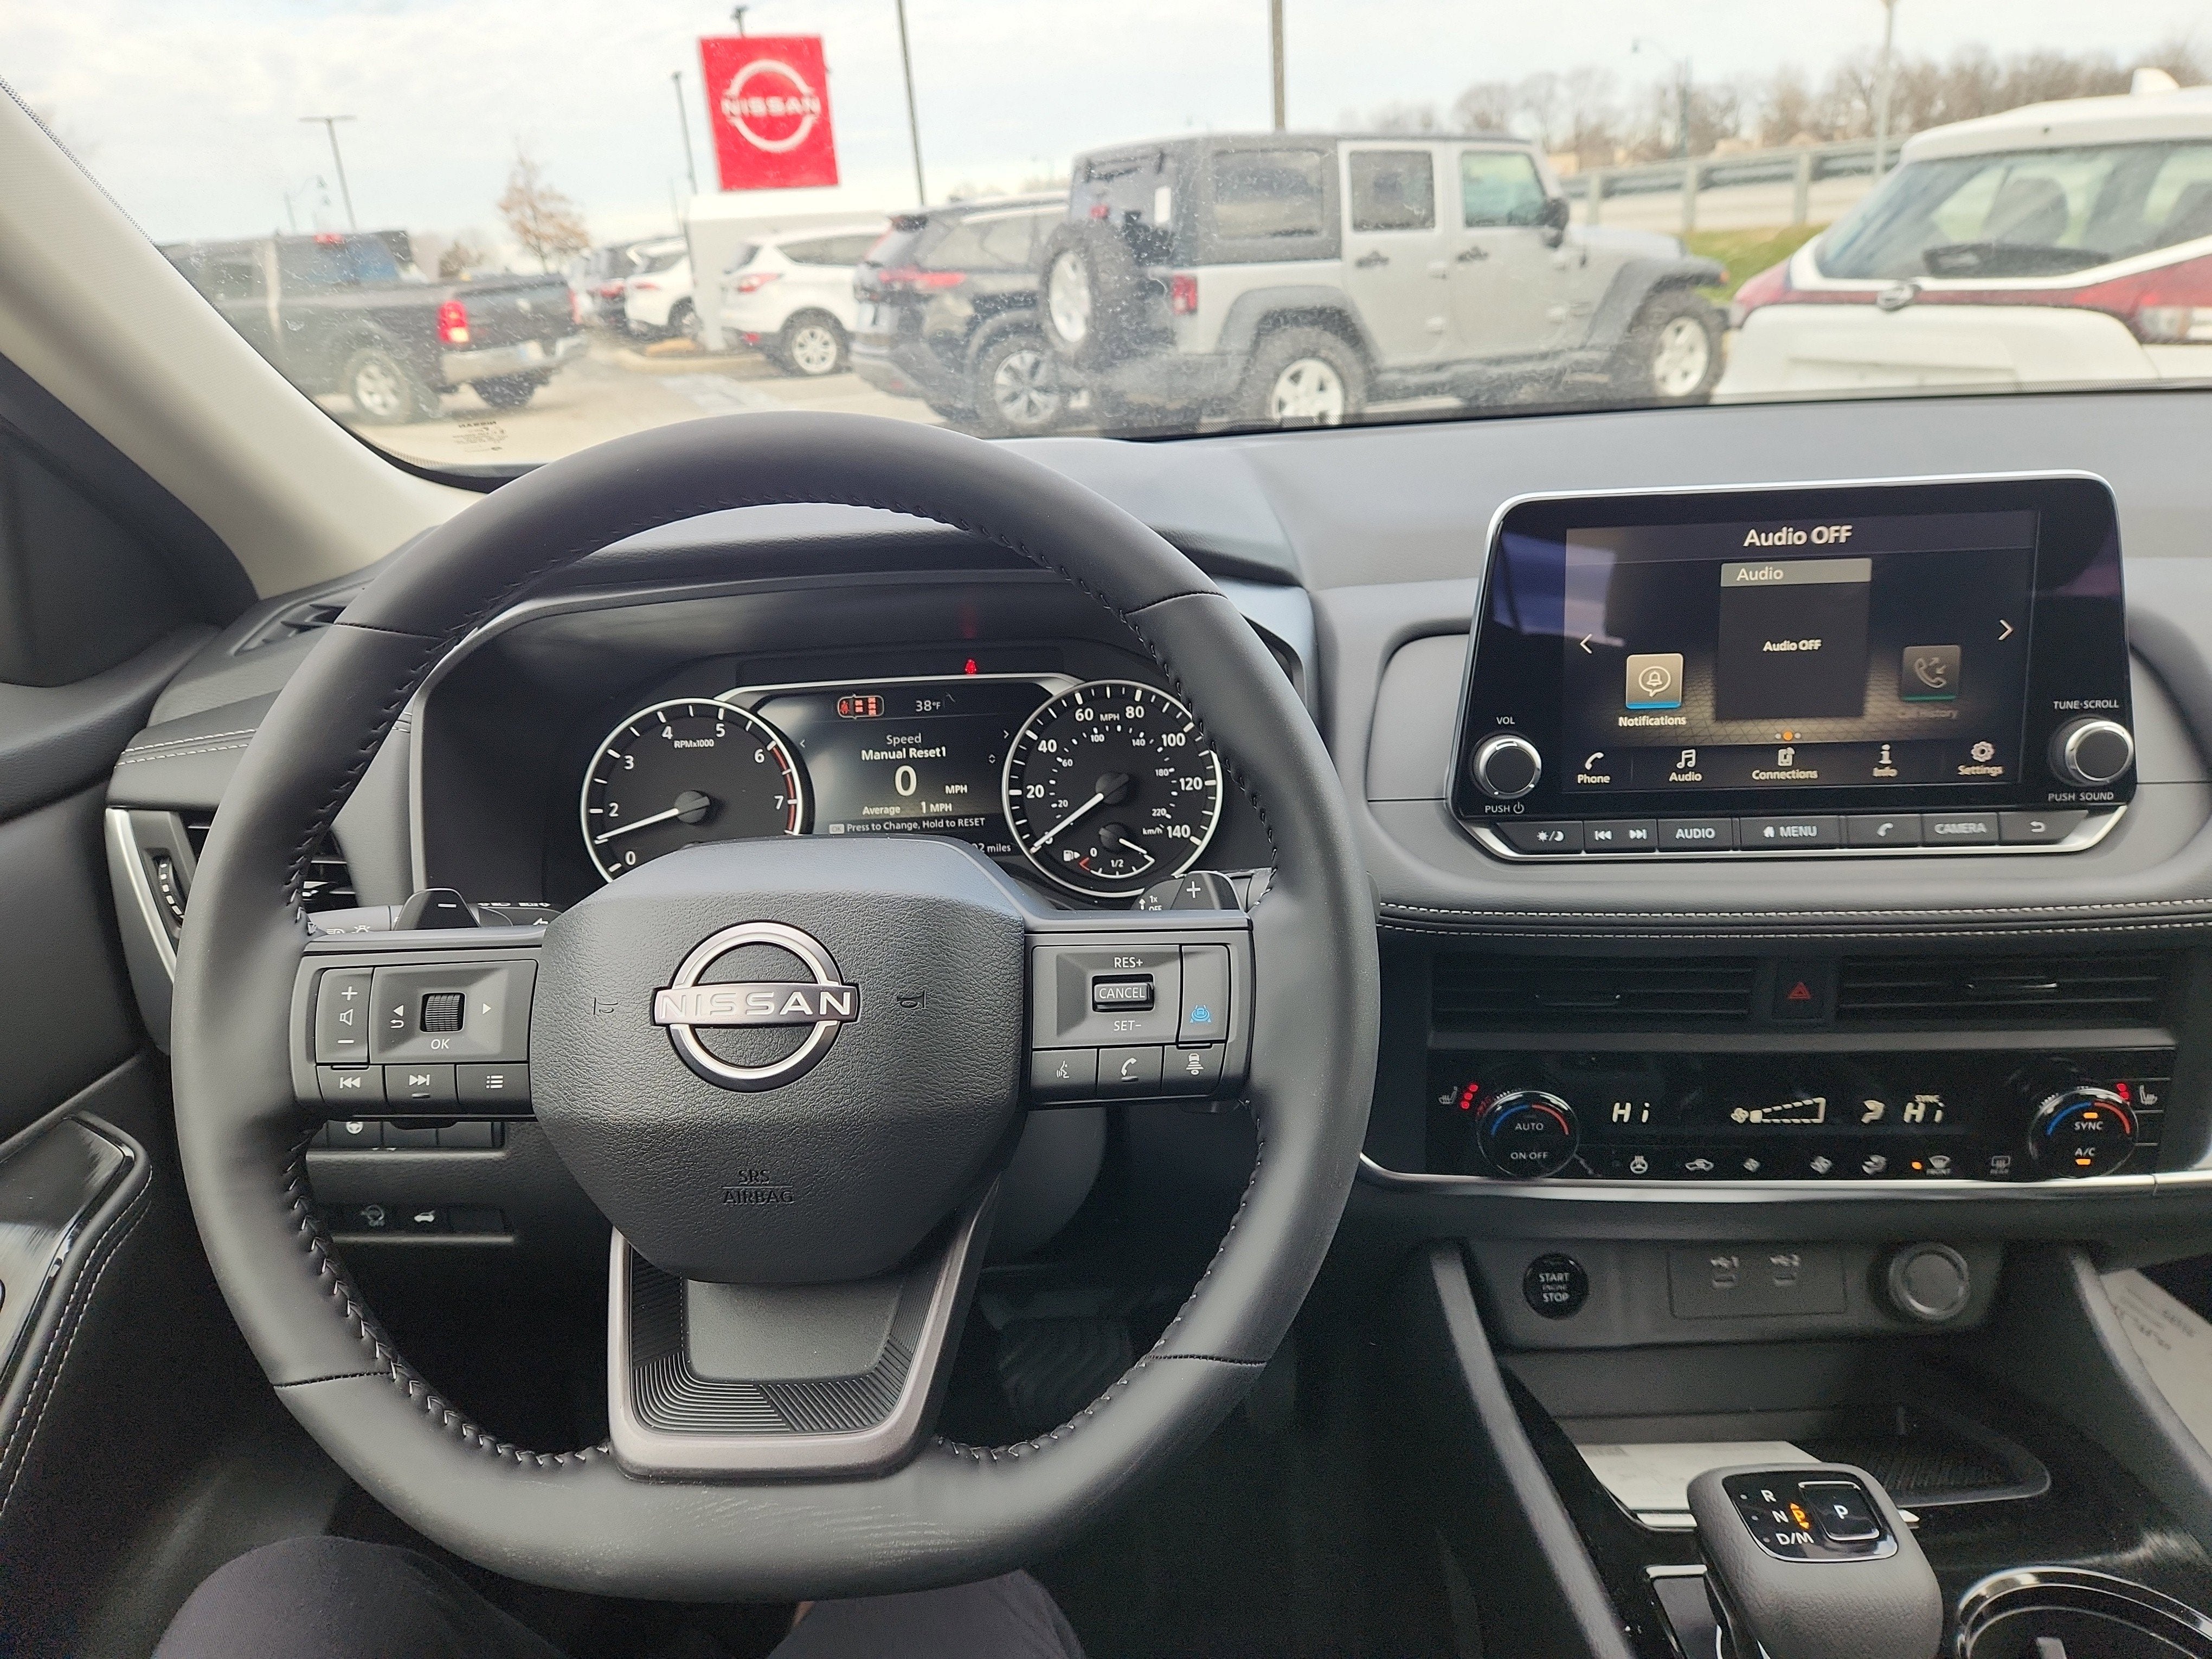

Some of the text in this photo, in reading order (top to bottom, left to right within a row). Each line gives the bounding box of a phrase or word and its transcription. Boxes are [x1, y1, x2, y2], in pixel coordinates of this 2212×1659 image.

[721, 95, 821, 118] NISSAN
[1743, 525, 1853, 547] Audio OFF
[1737, 567, 1784, 581] Audio
[1763, 639, 1822, 652] Audio OFF
[1075, 708, 1094, 722] 60
[1099, 713, 1120, 722] MPH
[1126, 705, 1144, 718] 80
[1496, 716, 1515, 725] VOL
[1618, 715, 1687, 728] Notifications
[662, 726, 673, 740] 4
[716, 724, 725, 737] 5
[674, 739, 714, 748] RPMx1000
[886, 733, 921, 747] Speed
[1090, 734, 1105, 742] 100
[1132, 738, 1146, 747] 140
[1162, 733, 1186, 747] 100
[1038, 740, 1057, 753] 40
[755, 749, 764, 763] 6
[861, 747, 946, 761] Manual Reset1
[624, 755, 633, 769] 3
[1062, 759, 1073, 767] 60
[1155, 769, 1169, 777] 180
[1669, 771, 1702, 782] Audio
[1752, 769, 1818, 780] Connections
[1957, 764, 2004, 776] Settings
[895, 765, 967, 796] 0 MPH
[1179, 777, 1203, 791] 120
[1577, 774, 1611, 784] Phone
[1026, 785, 1045, 799] 20
[2048, 792, 2114, 802] PUSH SOUND
[775, 795, 784, 810] 7
[863, 802, 952, 816] Average 1 MPH
[1057, 800, 1069, 808] 20
[1485, 805, 1510, 813] PUSH
[609, 803, 619, 816] 2
[1152, 808, 1167, 816] 220
[847, 824, 870, 832] Press
[871, 822, 882, 831] to
[883, 821, 921, 831] Change,
[923, 820, 944, 828] Hold
[958, 818, 985, 827] RESET
[1142, 826, 1162, 835] km/h
[1167, 825, 1191, 838] 140
[1779, 826, 1817, 837] MENU
[1934, 822, 1987, 834] CAMERA
[1675, 828, 1715, 840] AUDIO
[987, 843, 1011, 853] miles
[1090, 848, 1098, 857] 0
[626, 851, 635, 865] 0
[1111, 859, 1124, 868] 1/2
[1149, 895, 1158, 903] 1x
[1099, 987, 1145, 999] CANCEL
[659, 992, 851, 1019] NISSAN
[430, 1038, 451, 1050] OK
[1612, 1102, 1650, 1123] Hi
[2074, 1121, 2104, 1130] SYNC
[2075, 1147, 2095, 1156] A/C
[738, 1169, 770, 1184] SRS
[723, 1190, 795, 1205] AIRBAG
[1539, 1272, 1569, 1282] START
[1543, 1293, 1569, 1302] STOP
[1760, 1489, 1776, 1502] R
[1772, 1509, 1805, 1523] N P
[1834, 1504, 1848, 1519] P
[1776, 1532, 1814, 1545] D/M
